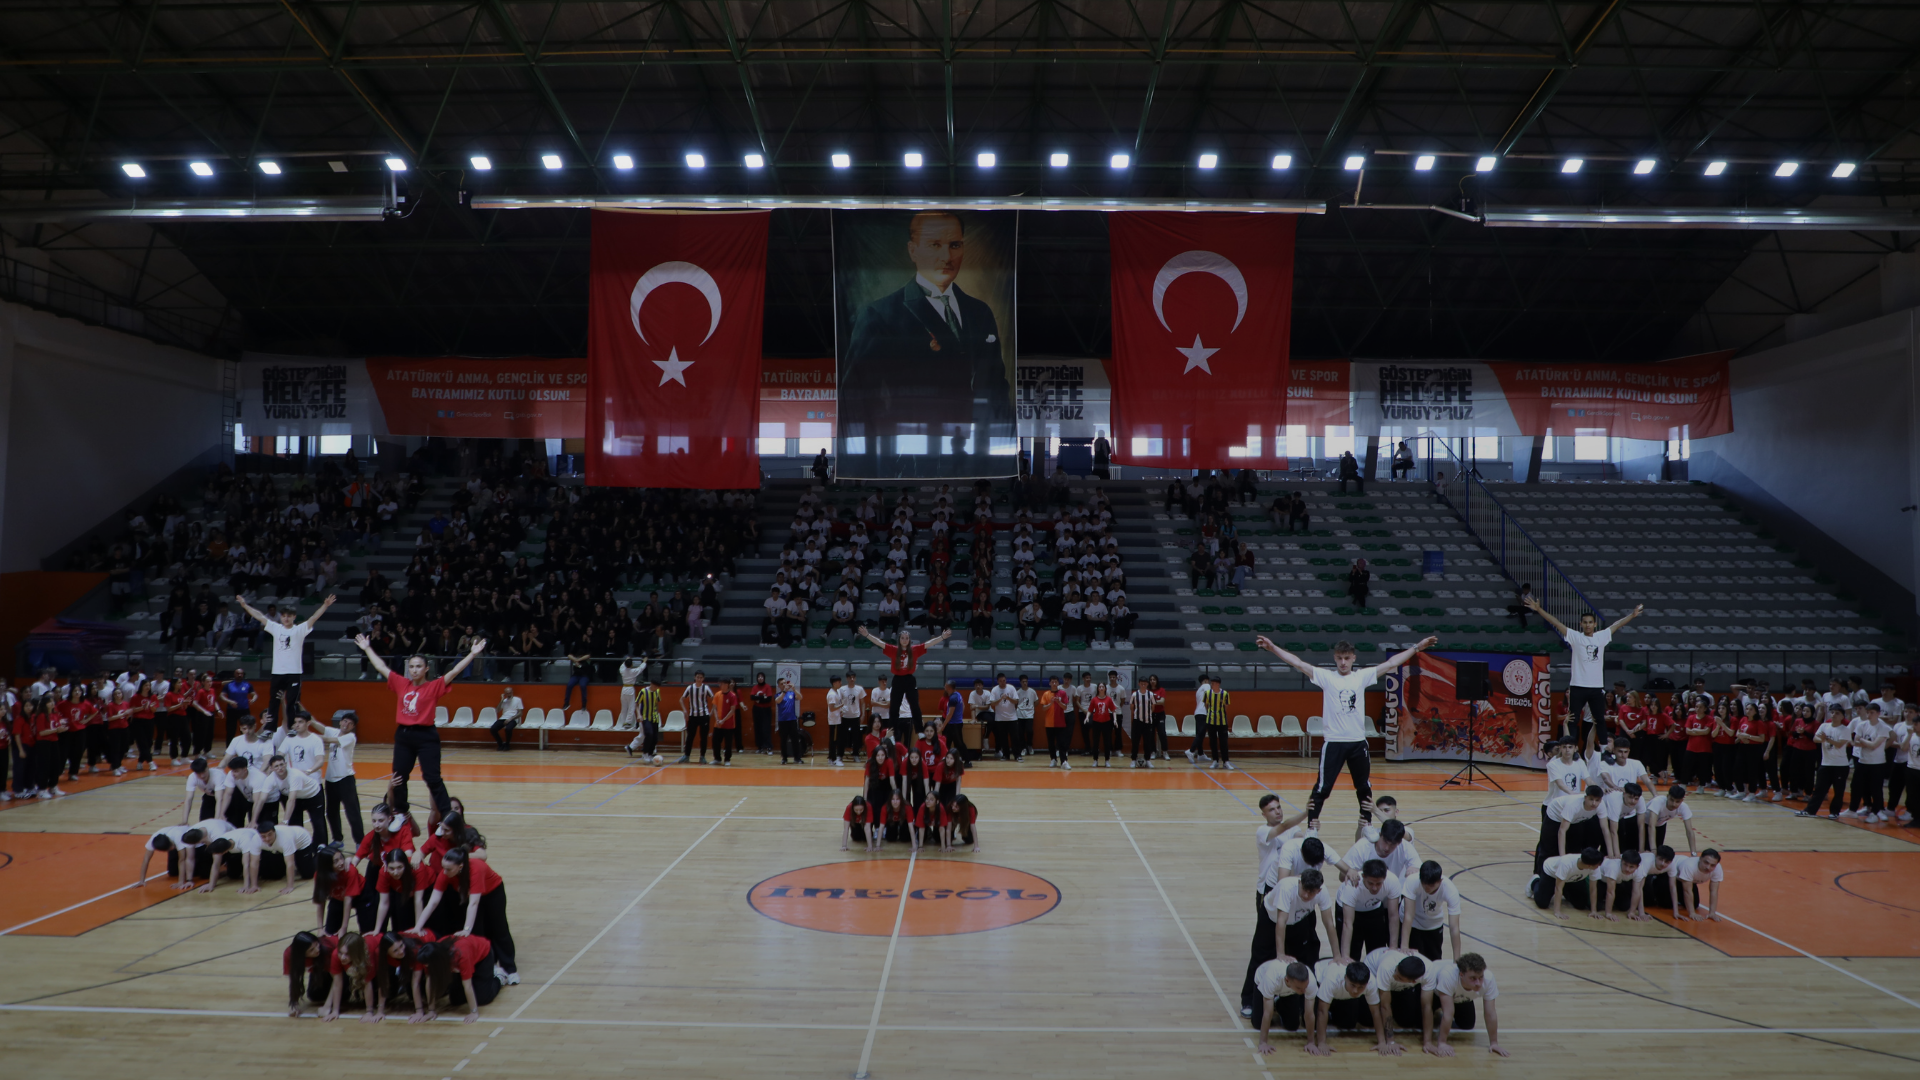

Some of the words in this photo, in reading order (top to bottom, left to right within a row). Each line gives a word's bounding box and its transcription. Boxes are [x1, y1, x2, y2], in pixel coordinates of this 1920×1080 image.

[387, 369, 453, 383] ATATÜRK'Ü
[456, 372, 493, 385] ANMA,
[496, 371, 545, 387] GENÇLİK
[548, 373, 563, 385] VE
[566, 373, 588, 385] SPO
[1291, 369, 1307, 381] VE
[1309, 369, 1339, 382] SPOR
[1515, 368, 1581, 382] ATATÜRK'Ü
[1585, 370, 1621, 383] ANMA,
[1624, 371, 1669, 388] GENÇLİK
[1673, 376, 1689, 388] VE
[411, 388, 484, 400] BAYRAMIMIZ
[488, 389, 525, 401] KUTLU
[529, 389, 570, 401] OLSUN!
[781, 389, 837, 401] BAYRAMI
[1286, 386, 1314, 398] SUN!
[1541, 386, 1613, 399] BAYRAMIMIZ
[1616, 388, 1650, 402] KUTLU
[1654, 392, 1698, 404] OLSUN!
